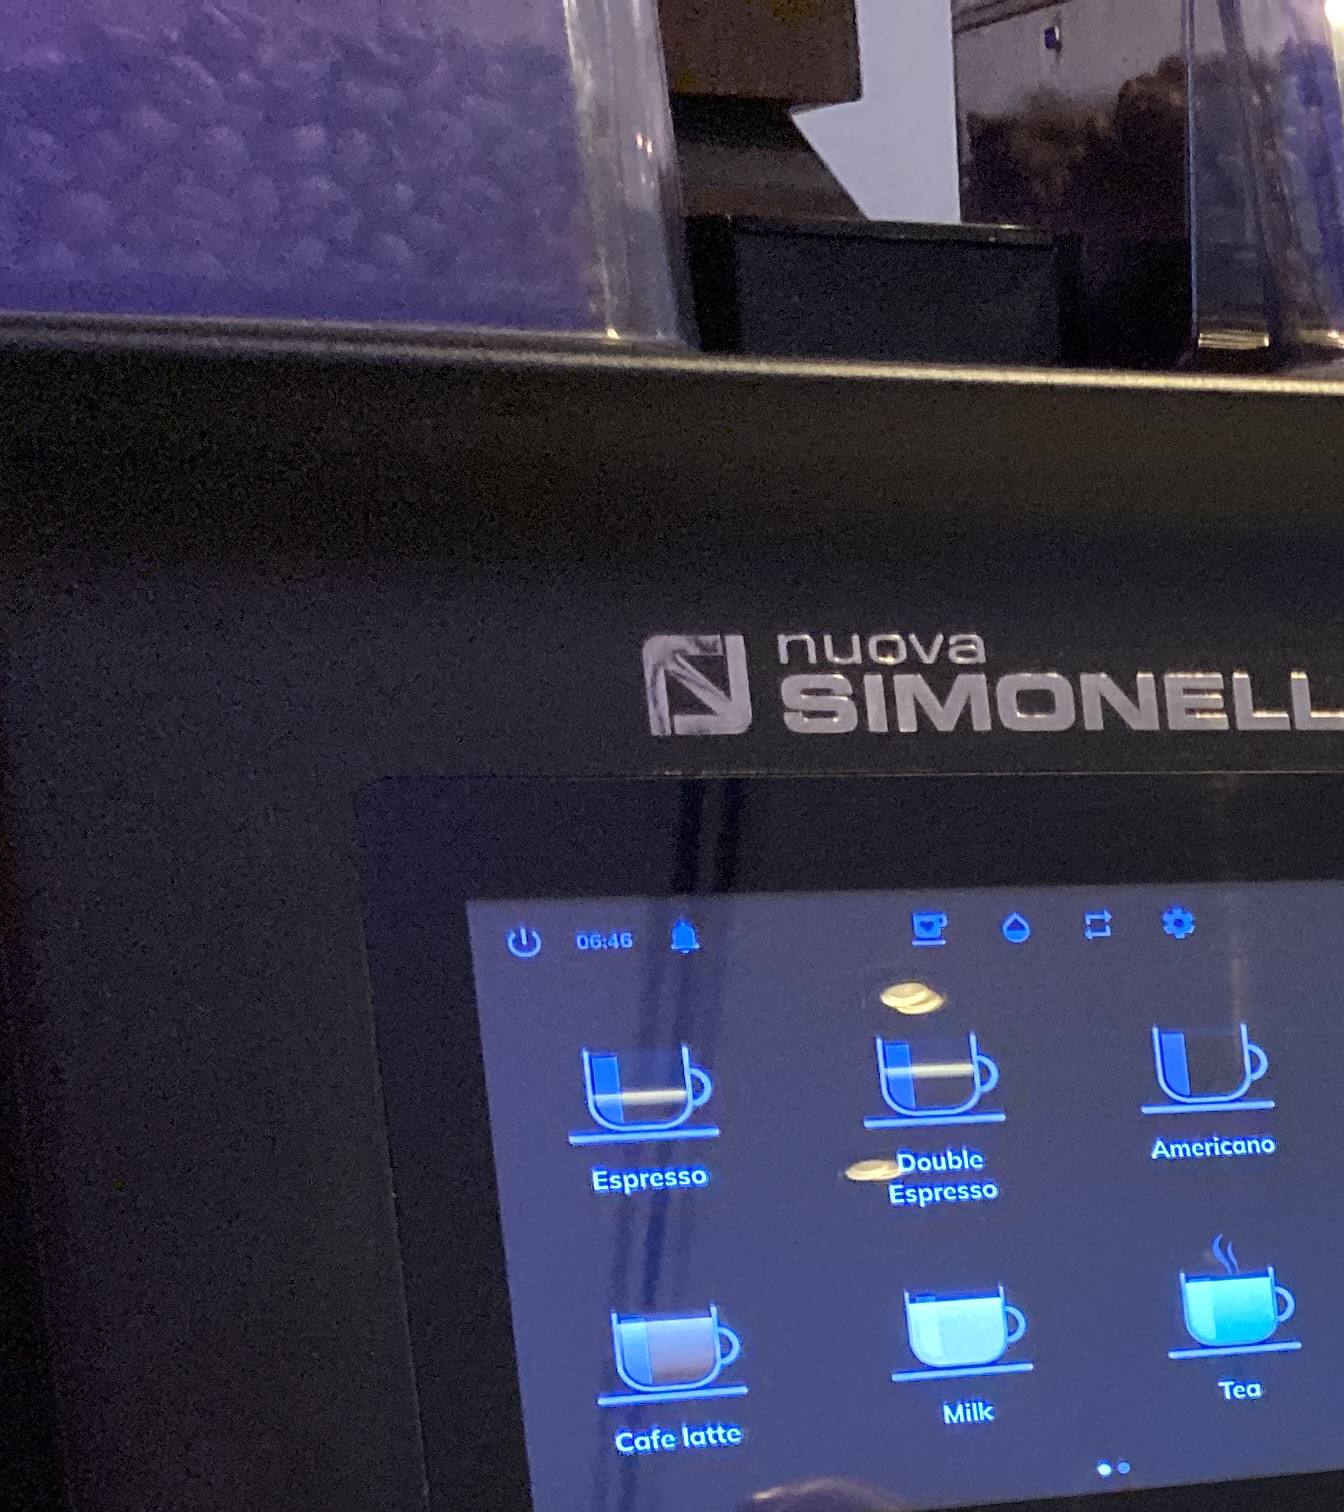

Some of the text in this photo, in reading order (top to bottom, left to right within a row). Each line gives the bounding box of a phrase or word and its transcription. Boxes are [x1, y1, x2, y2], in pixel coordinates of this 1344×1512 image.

[777, 633, 986, 666] nuova
[575, 932, 633, 950] 06:46
[897, 1145, 985, 1173] Double
[1151, 1135, 1277, 1160] Americano
[591, 1167, 710, 1195] Espresso
[888, 1181, 999, 1207] Espresso
[1218, 1379, 1262, 1400] Tea
[942, 1400, 995, 1424] Milk
[615, 1422, 743, 1454] Cafe latte
